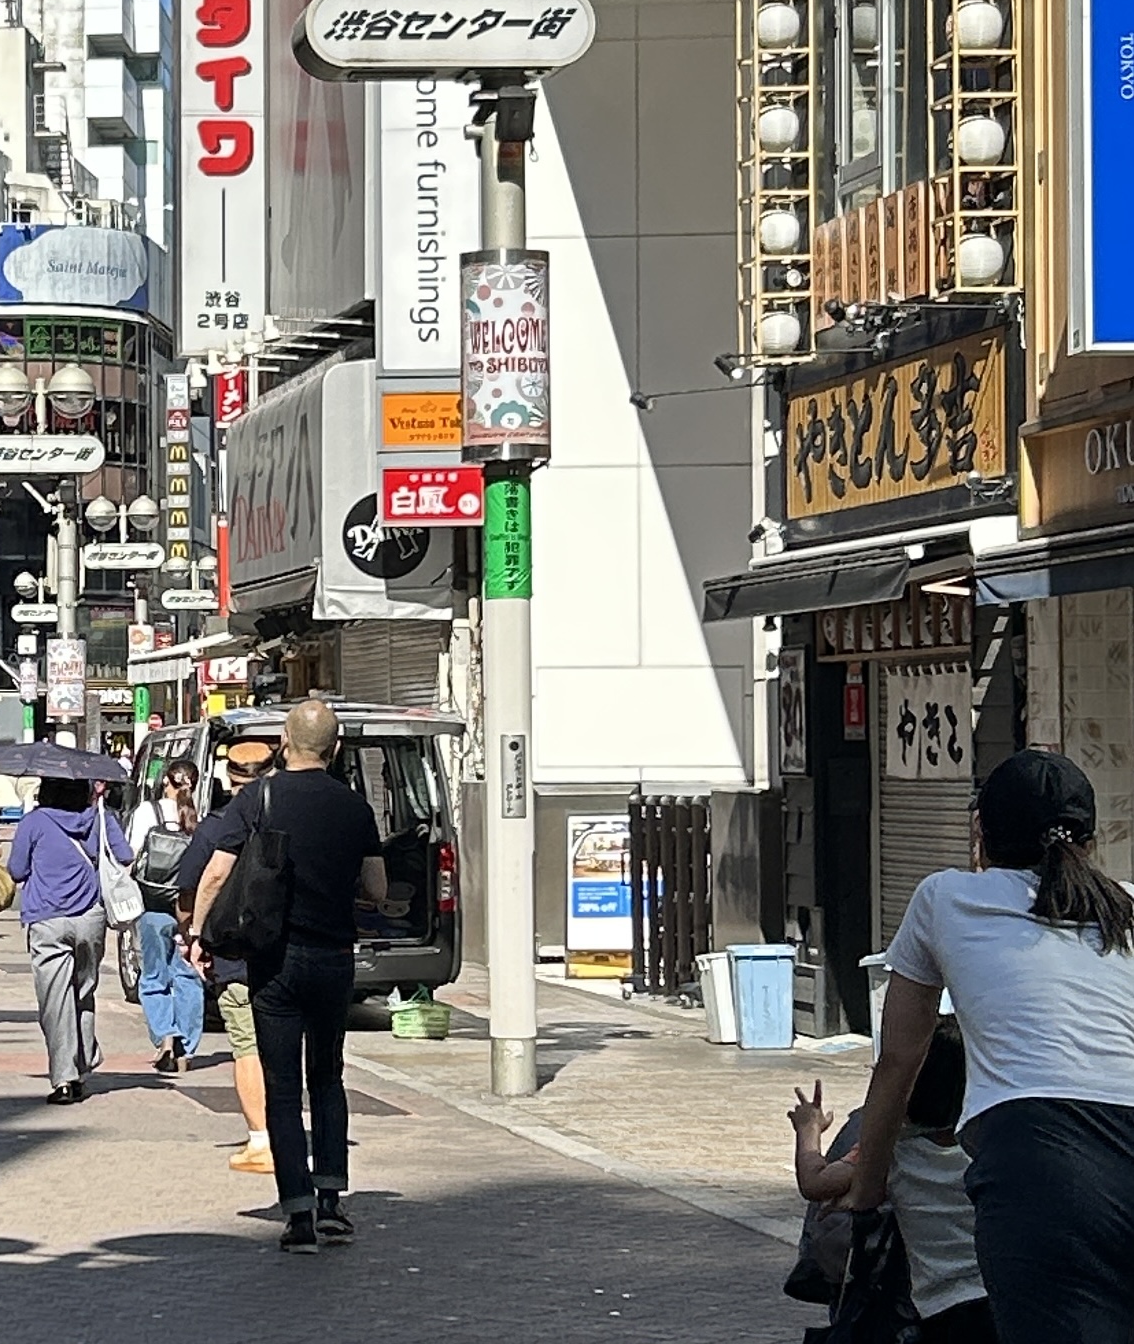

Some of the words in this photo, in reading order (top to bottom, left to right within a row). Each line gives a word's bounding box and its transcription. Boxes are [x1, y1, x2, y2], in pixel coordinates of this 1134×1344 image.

[323, 7, 577, 41] 渋谷センター街
[415, 79, 439, 148] ome
[409, 159, 447, 343] furnishings
[47, 259, 83, 274] Saint
[204, 290, 241, 309] 渋谷
[196, 312, 250, 331] 2号店
